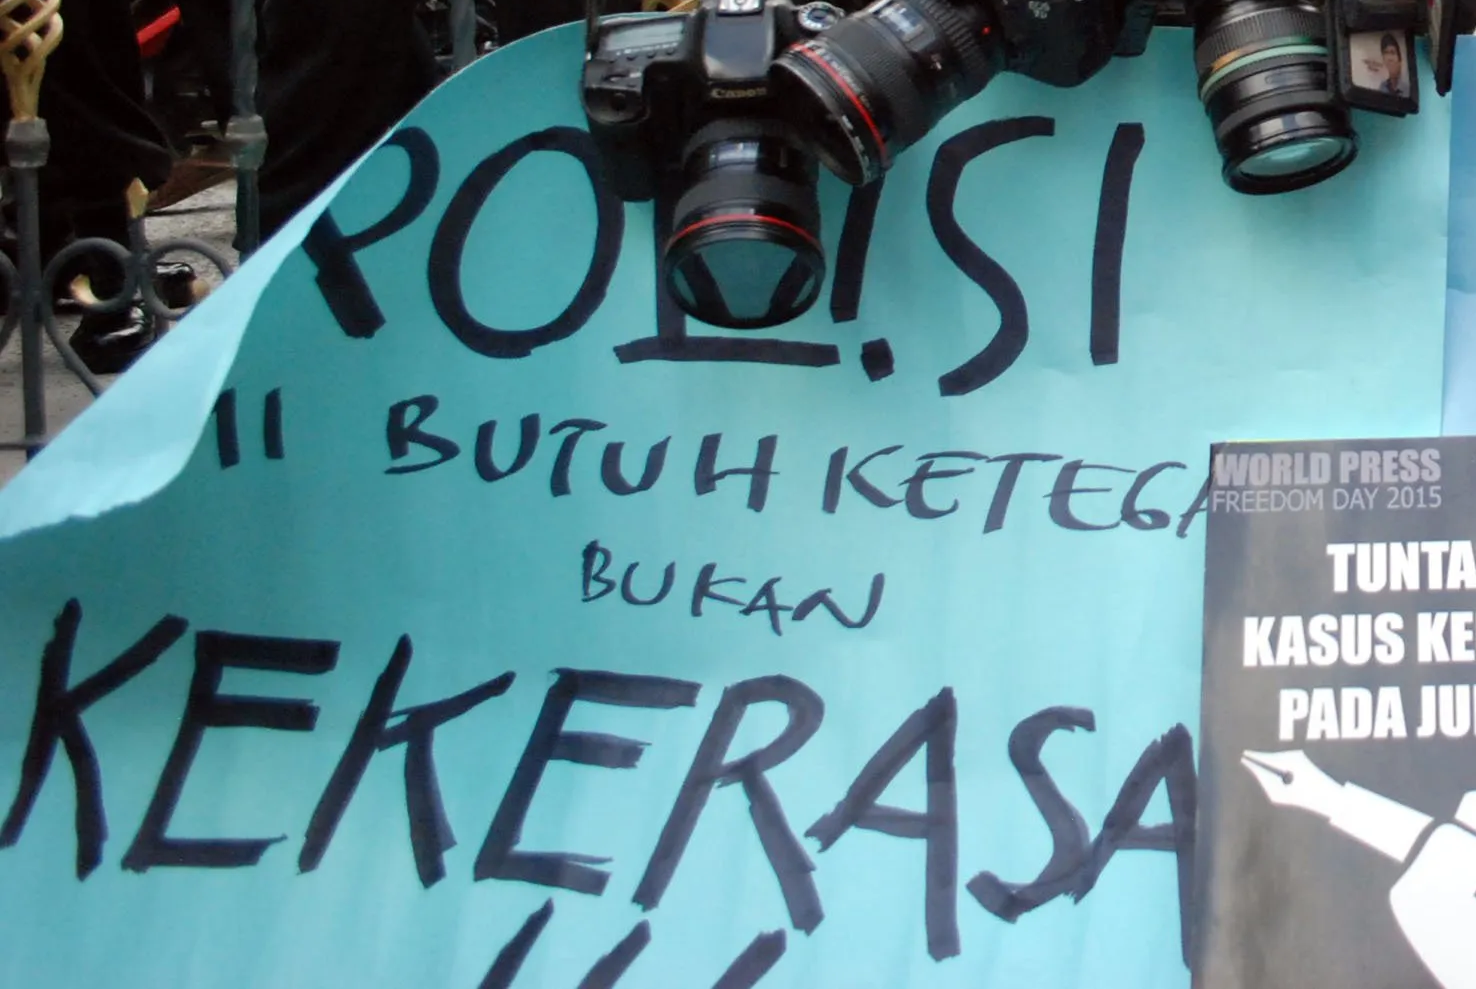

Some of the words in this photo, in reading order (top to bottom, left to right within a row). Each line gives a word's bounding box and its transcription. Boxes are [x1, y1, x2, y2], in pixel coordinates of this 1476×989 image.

[711, 86, 767, 100] Canon
[385, 394, 779, 513] BUTUH
[1214, 452, 1331, 488] WORLD
[1339, 447, 1442, 485] PRESS
[1211, 488, 1325, 514] FREEDOM
[1332, 487, 1382, 511] DAY
[1387, 485, 1443, 510] 2015
[582, 540, 885, 636] BUKAN
[1242, 613, 1405, 668] KASUS
[1278, 685, 1407, 742] PADA
